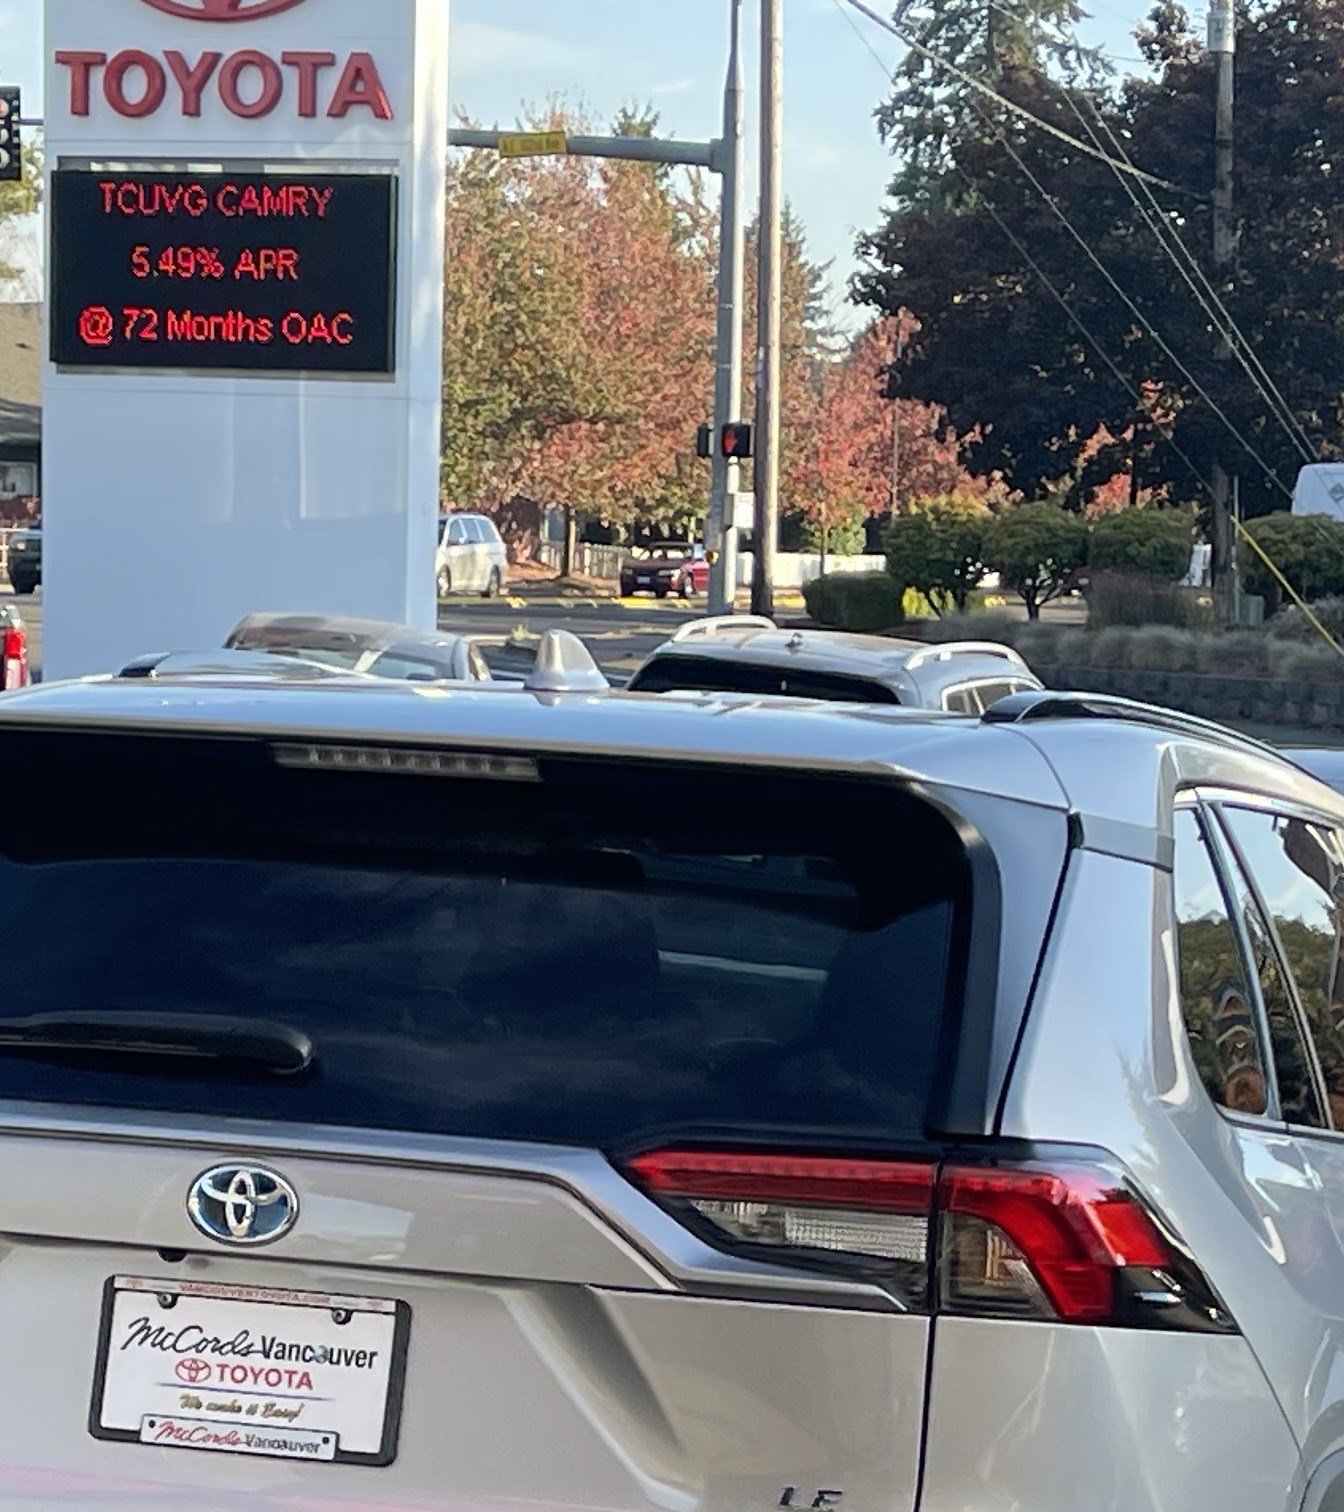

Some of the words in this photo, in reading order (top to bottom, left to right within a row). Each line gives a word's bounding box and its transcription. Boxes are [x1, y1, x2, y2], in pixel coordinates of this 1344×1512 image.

[55, 49, 394, 120] TOYOTA
[215, 182, 334, 218] CAMRY
[131, 244, 224, 281] 5.49%
[233, 247, 299, 281] APR
[78, 305, 114, 347] @
[122, 308, 158, 342] 72
[167, 309, 273, 344] Months
[282, 312, 355, 346] OAC
[216, 1363, 314, 1391] TOYOTA
